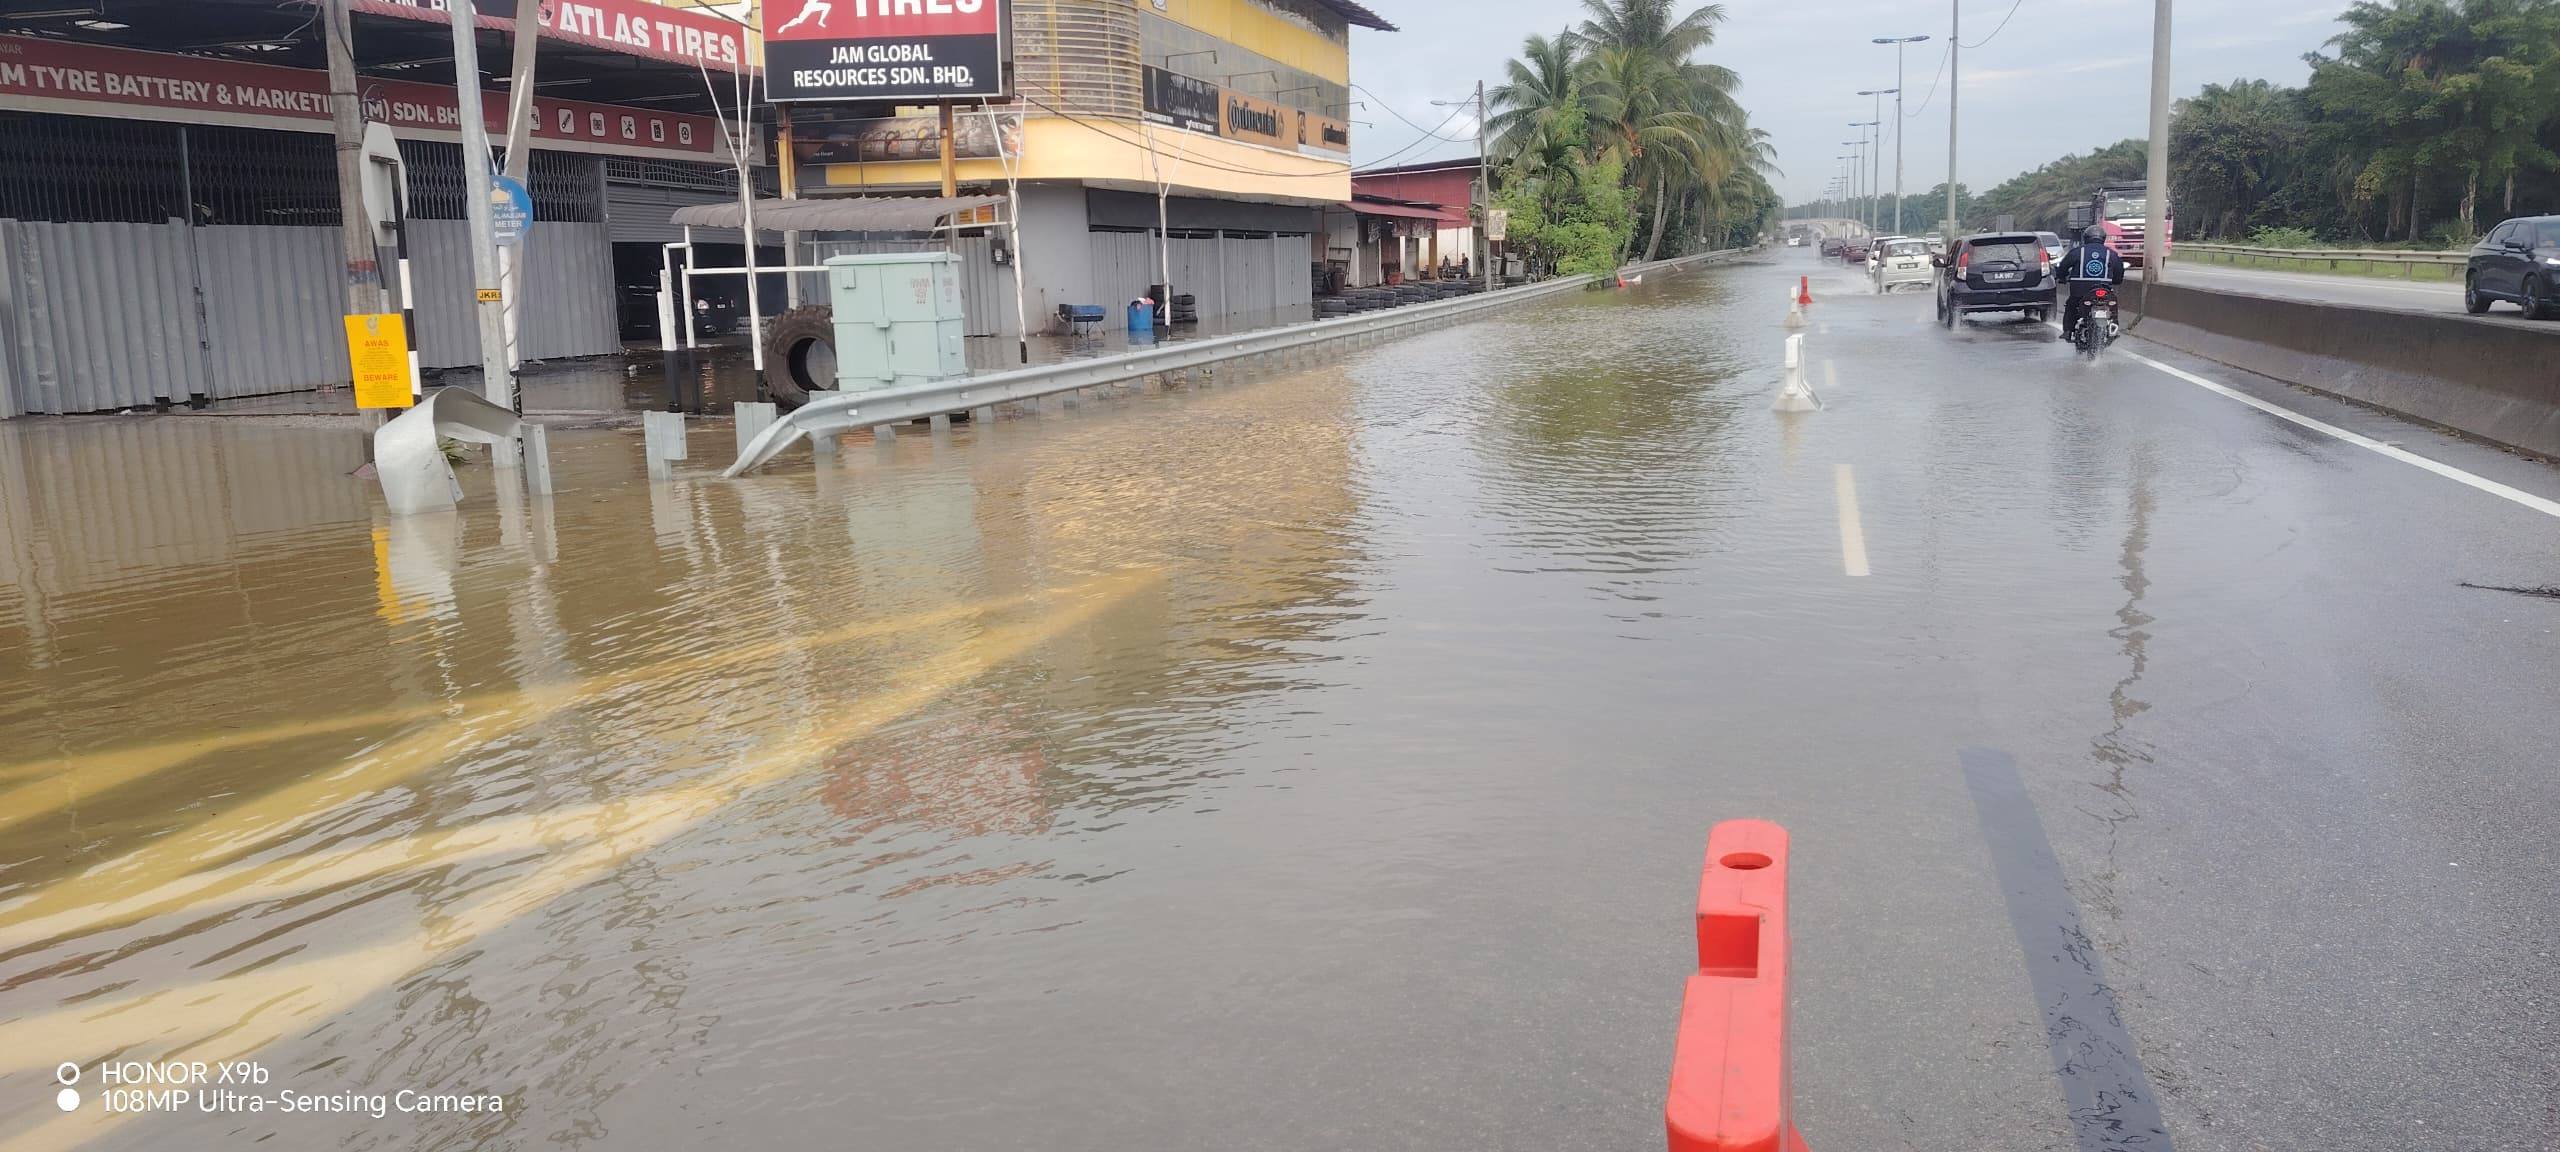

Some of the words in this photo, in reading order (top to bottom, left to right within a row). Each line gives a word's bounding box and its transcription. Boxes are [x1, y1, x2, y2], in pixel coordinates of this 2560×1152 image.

[559, 2, 650, 48] ATLAS
[655, 21, 736, 65] TIRES
[830, 46, 864, 64] JAM
[867, 44, 933, 62] GLOBAL
[793, 68, 886, 88] RESOURCES
[890, 67, 930, 85] SDN.
[933, 66, 974, 84] BHD.
[29, 64, 99, 93] TYRE
[105, 72, 210, 103] BATTERY
[216, 84, 232, 105] &
[392, 102, 434, 122] SDN.
[363, 374, 398, 382] BEWARE
